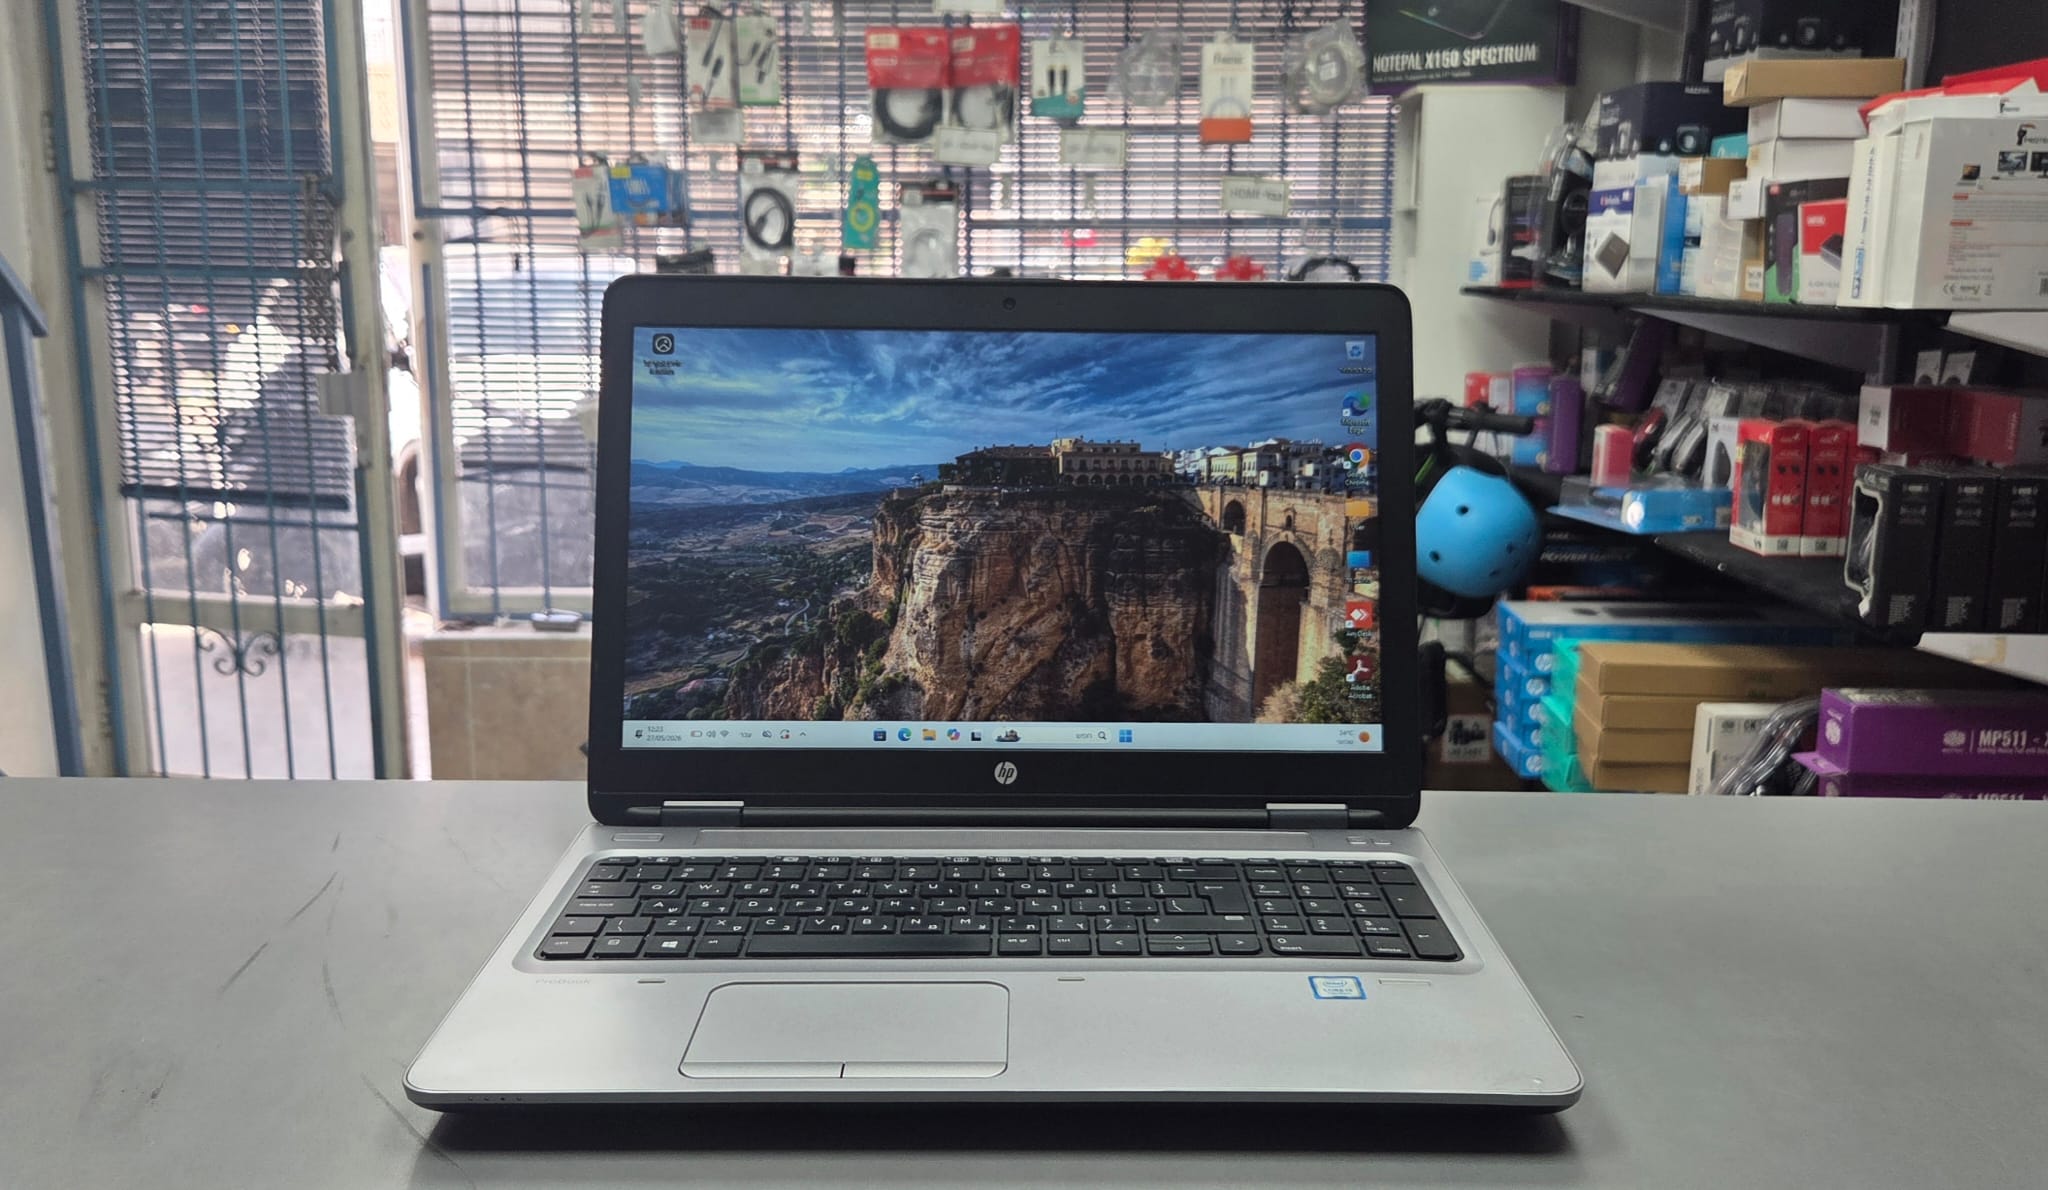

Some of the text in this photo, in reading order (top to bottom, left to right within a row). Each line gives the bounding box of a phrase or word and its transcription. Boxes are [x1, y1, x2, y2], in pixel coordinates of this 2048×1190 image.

[1373, 53, 1422, 73] NOTEPAL
[1463, 43, 1537, 67] SPECTRUM
[1979, 730, 2027, 749] MP511
[994, 761, 1018, 785] hp
